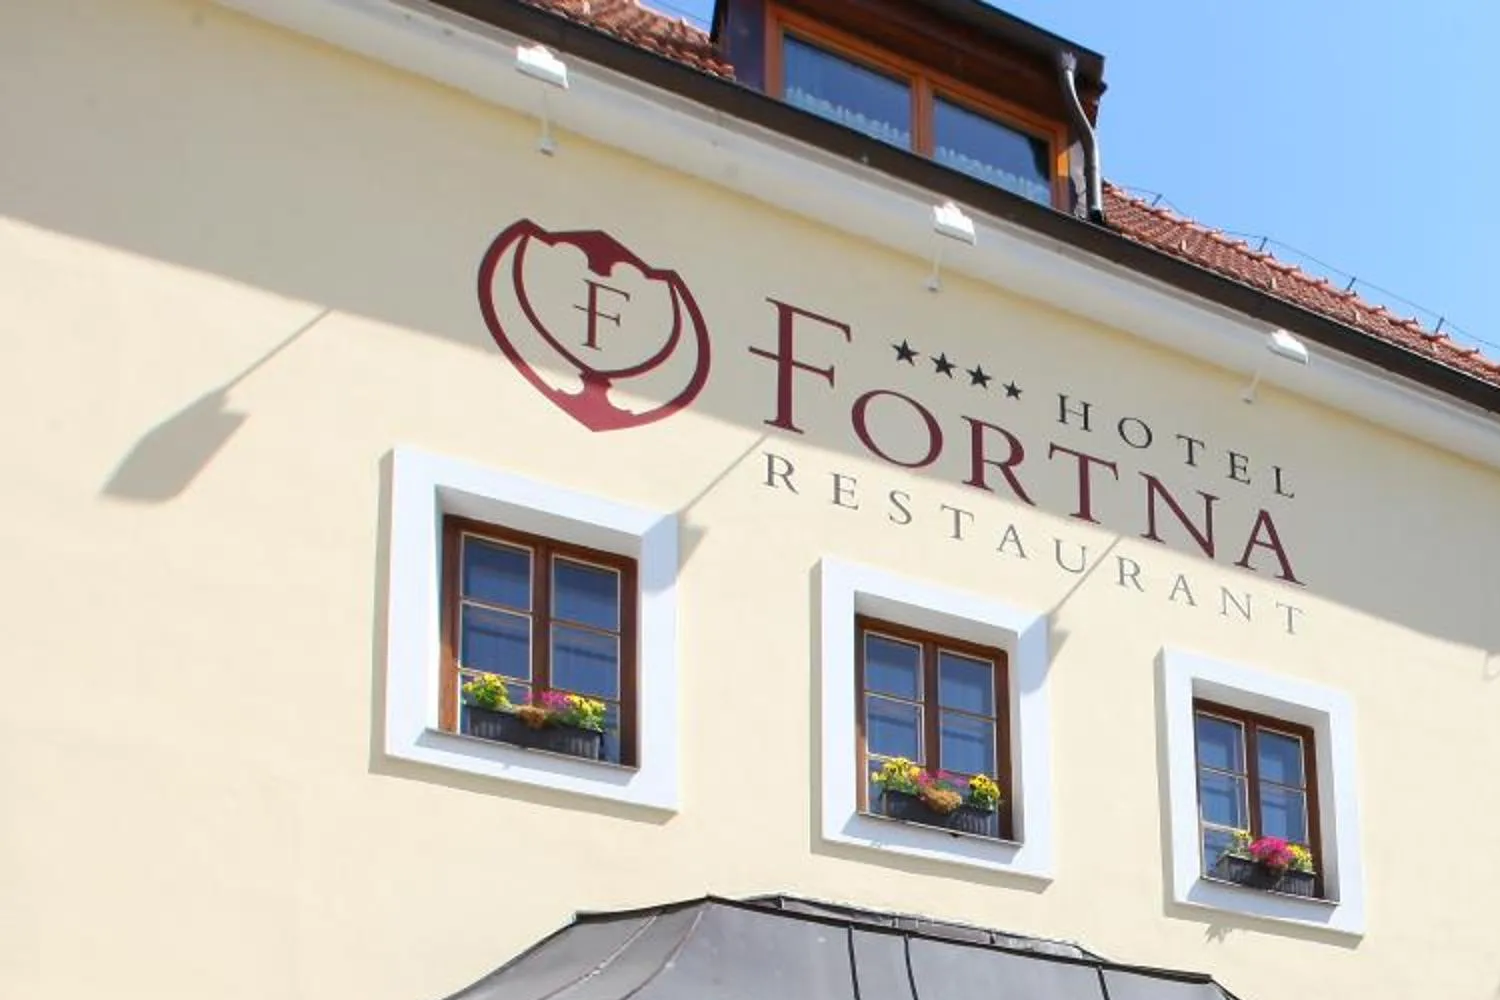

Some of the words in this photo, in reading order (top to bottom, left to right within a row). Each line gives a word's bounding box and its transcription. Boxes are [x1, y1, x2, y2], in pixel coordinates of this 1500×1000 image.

[572, 279, 632, 352] F
[747, 295, 1308, 588] FORTNA
[1056, 393, 1296, 500] HOTEL
[760, 451, 1306, 636] RESTAURANT
